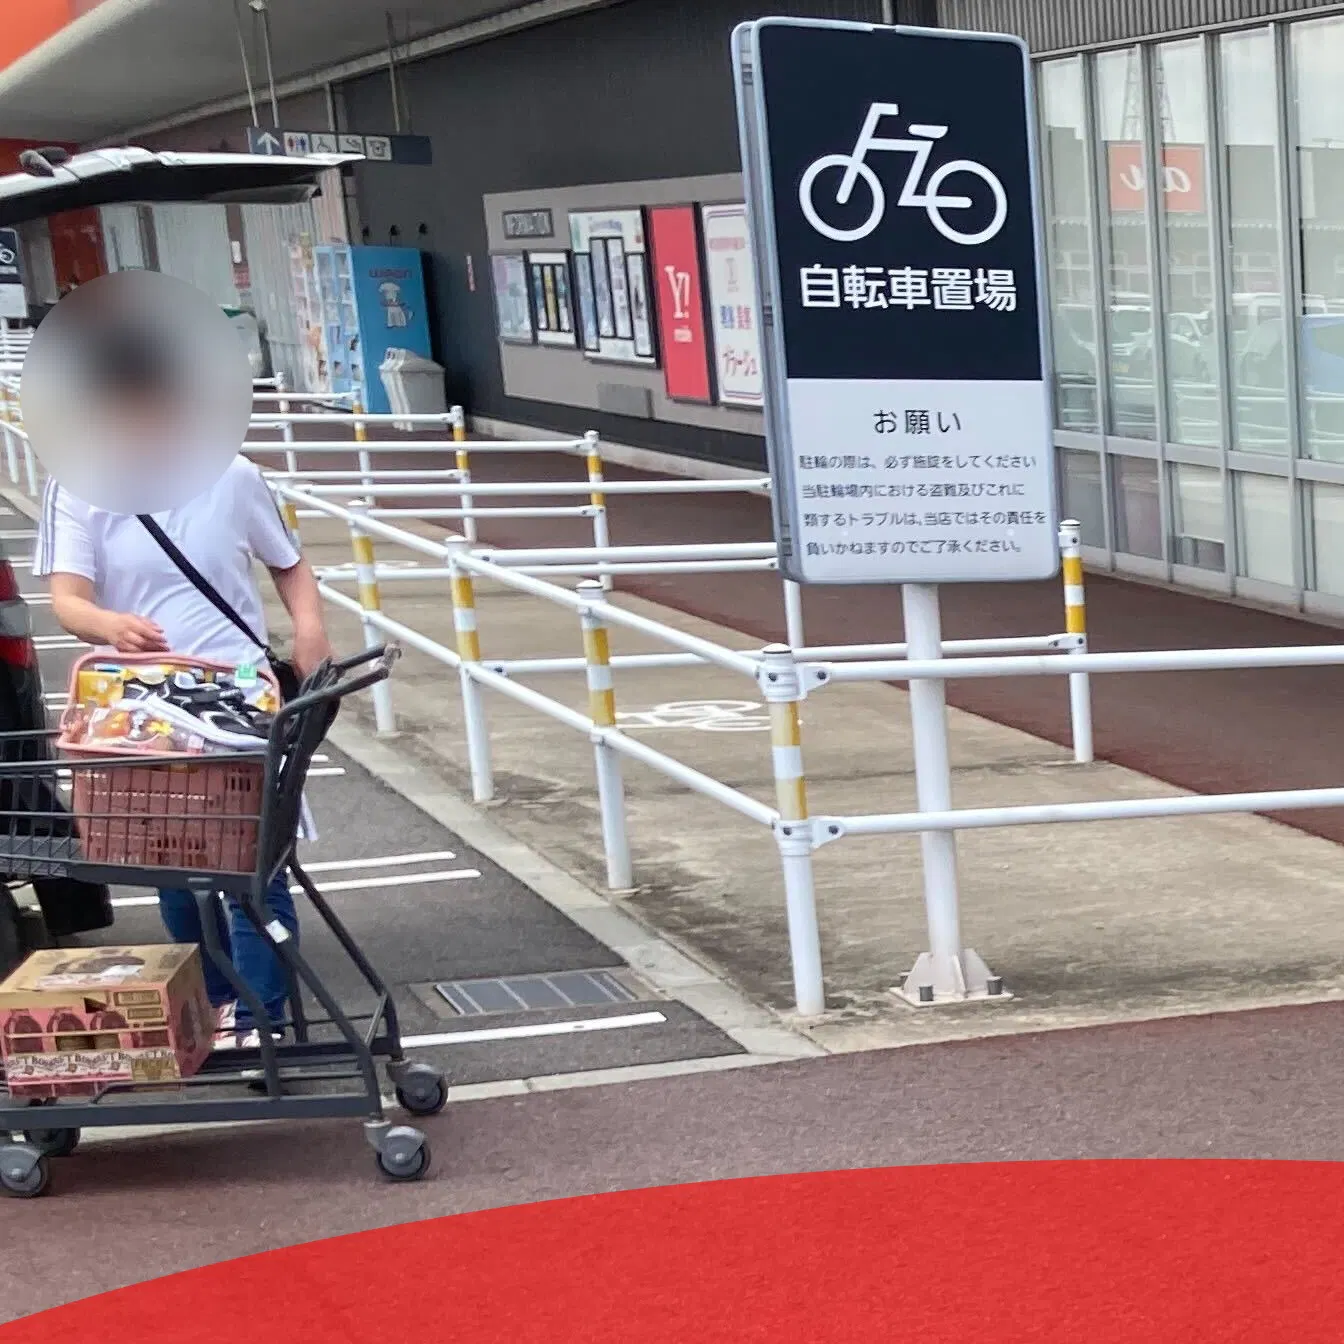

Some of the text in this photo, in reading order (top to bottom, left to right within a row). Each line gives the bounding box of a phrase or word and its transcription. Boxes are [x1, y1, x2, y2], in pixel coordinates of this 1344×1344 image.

[799, 263, 1017, 312] 自転車置場
[872, 409, 962, 435] お願い
[799, 454, 1037, 469] 駐輪の際は、必ず施錠をしてください
[802, 483, 1025, 499] 当駐輪場内における盗難及びこれに
[803, 511, 1046, 527] 類するトラブルは、当店ではその責任を
[806, 540, 1022, 556] 負いかねますのでご了承ください。
